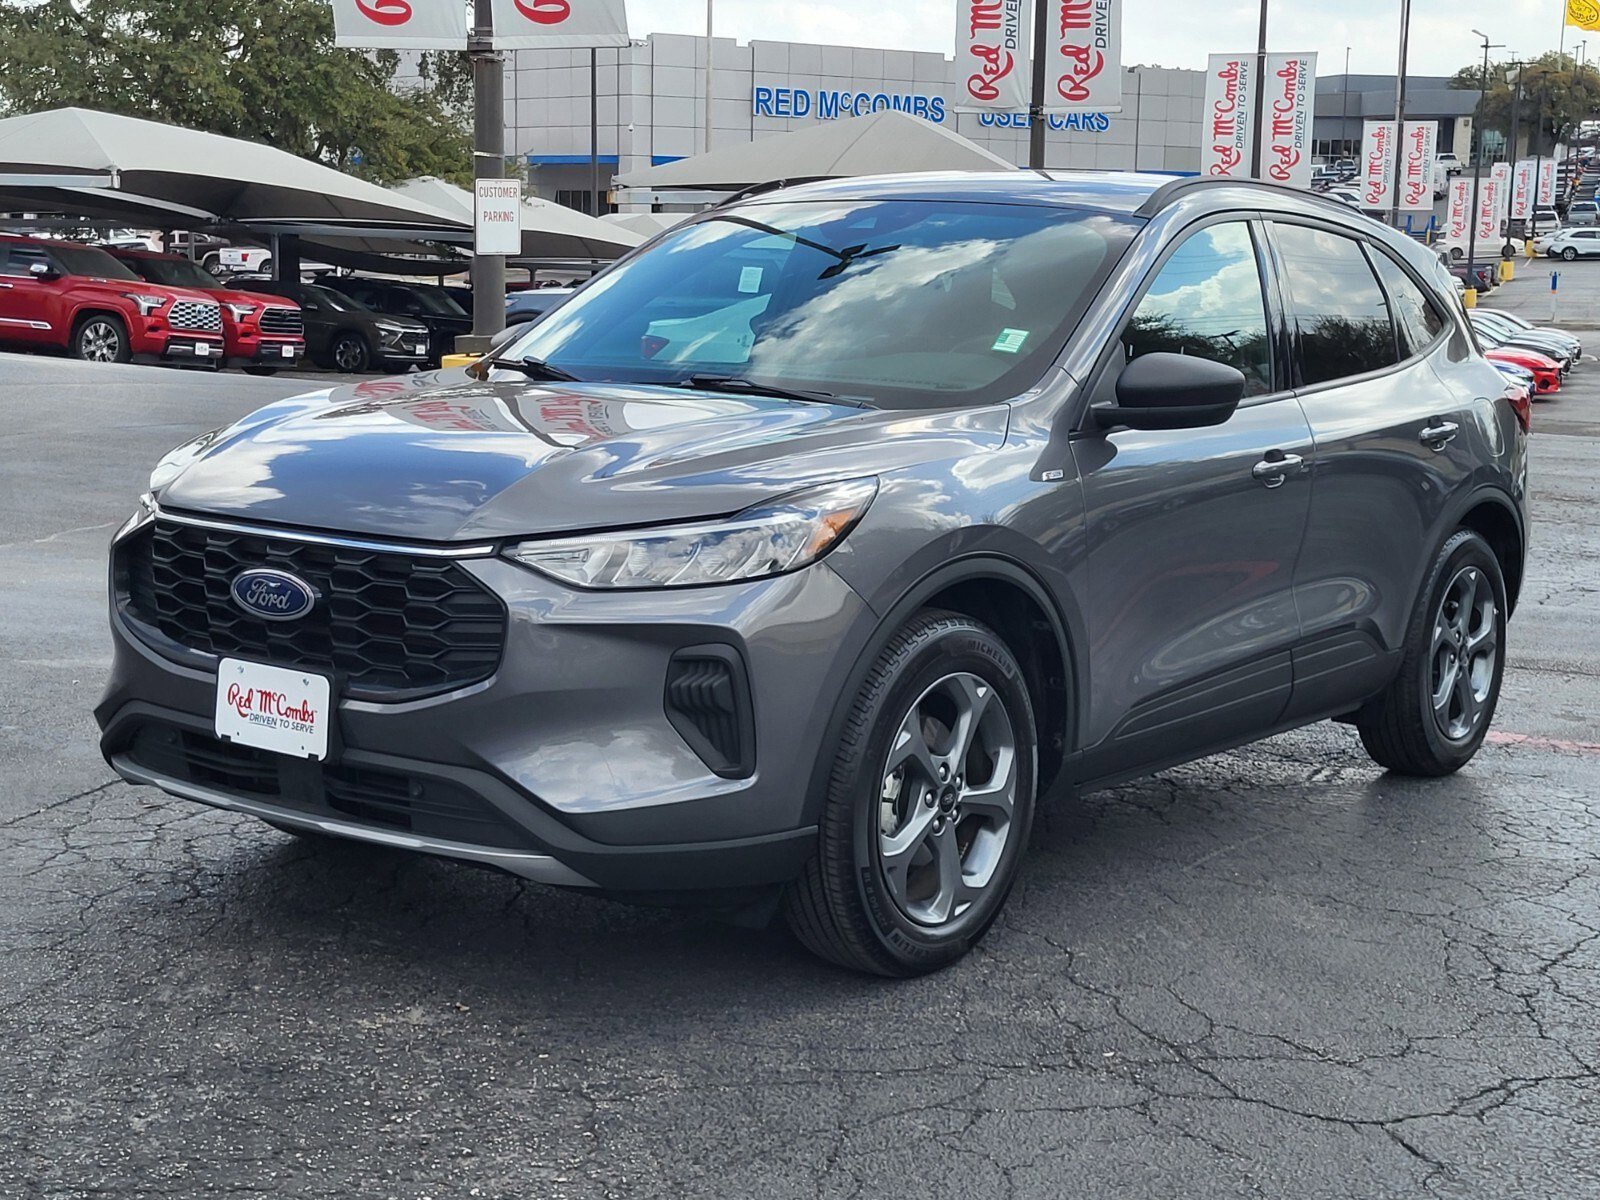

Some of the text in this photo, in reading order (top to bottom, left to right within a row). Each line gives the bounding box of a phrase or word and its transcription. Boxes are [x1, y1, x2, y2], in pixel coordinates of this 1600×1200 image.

[1094, 0, 1107, 49] DRIVE
[967, 44, 1014, 101] Red
[1057, 44, 1104, 101] Red
[755, 87, 811, 117] RED
[1213, 61, 1239, 142] McCombs
[1235, 61, 1249, 148] DRIVEN TO SERVE
[1269, 60, 1300, 180] Red McCombs
[1294, 60, 1308, 148] DRIVEN TO SERVE
[478, 186, 518, 198] CUSTOMER
[1365, 126, 1387, 204] Red McCombs
[1405, 126, 1426, 205] Red McCombs
[483, 211, 514, 222] PARKING
[246, 578, 292, 609] Ford
[227, 683, 315, 724] Red McCombs
[249, 712, 315, 734] DRIVEN TO SERVE
